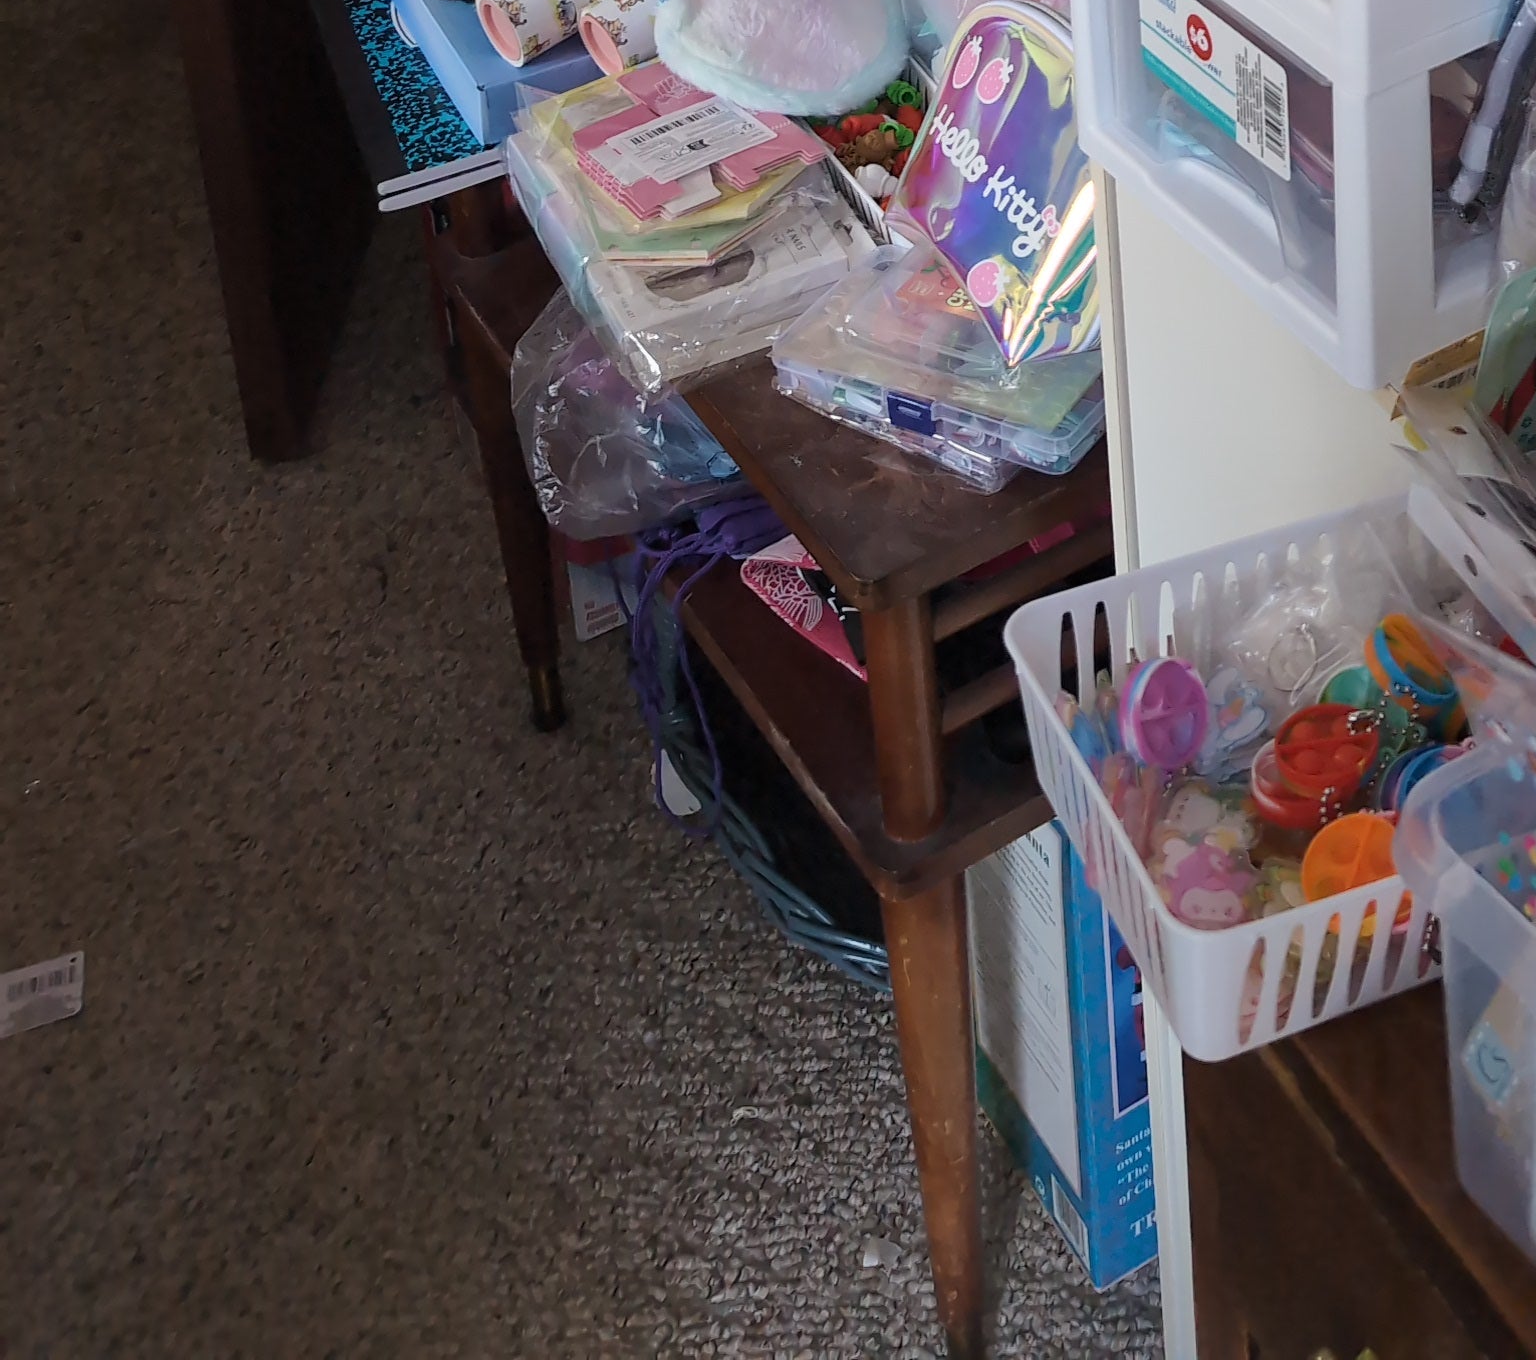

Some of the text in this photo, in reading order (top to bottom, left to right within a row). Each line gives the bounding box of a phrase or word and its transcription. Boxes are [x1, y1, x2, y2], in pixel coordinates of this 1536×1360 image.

[1188, 24, 1209, 51] $6
[929, 104, 1046, 258] Hello Kitty
[1116, 1154, 1142, 1174] own
[1119, 1185, 1131, 1206] of
